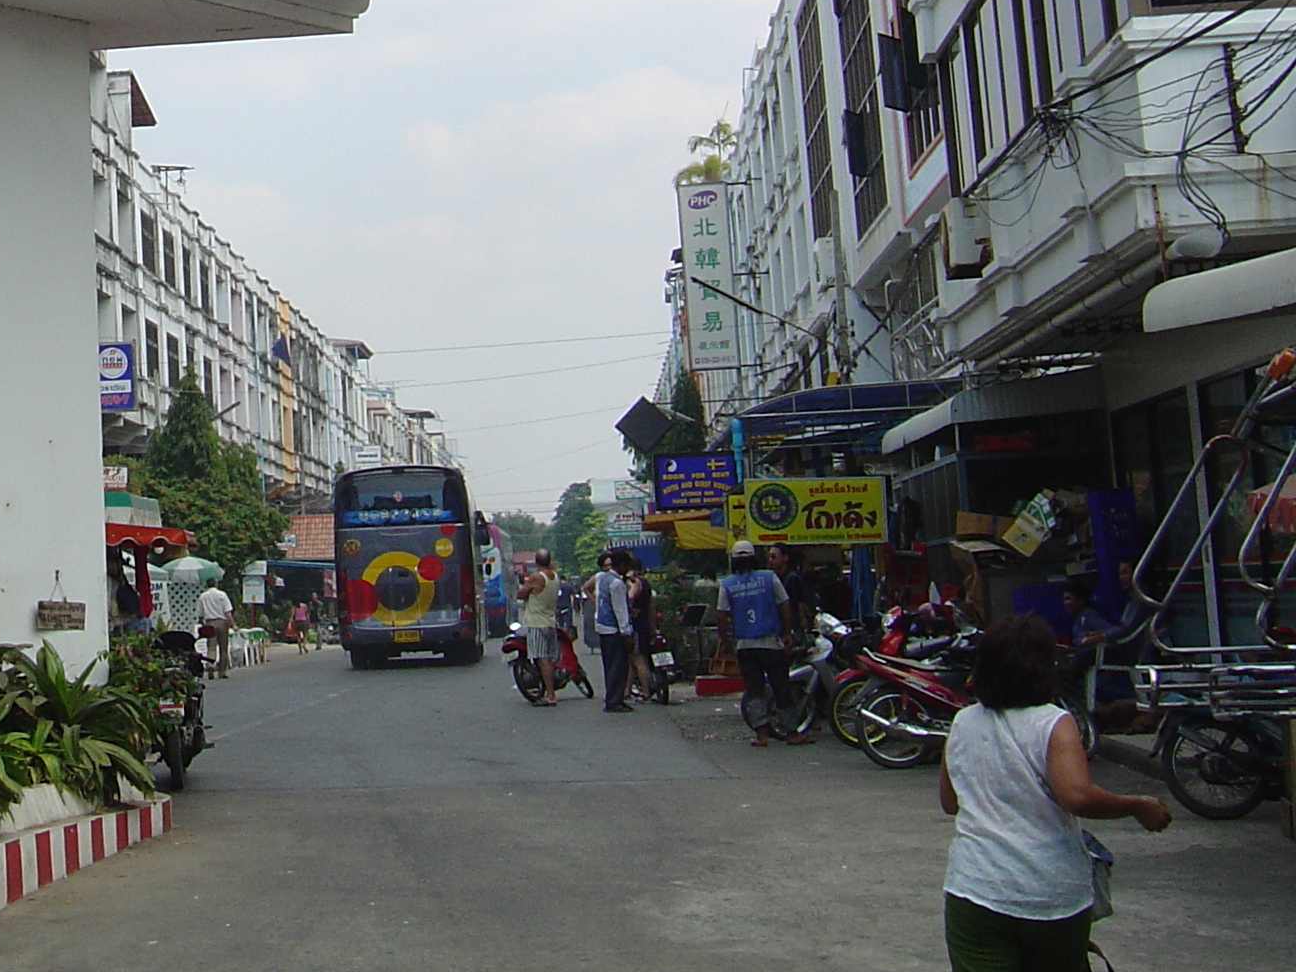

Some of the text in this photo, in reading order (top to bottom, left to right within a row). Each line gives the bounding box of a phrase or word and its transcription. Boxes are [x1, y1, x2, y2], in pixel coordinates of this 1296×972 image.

[693, 218, 723, 332] 北韓貿易
[747, 609, 756, 623] 3
